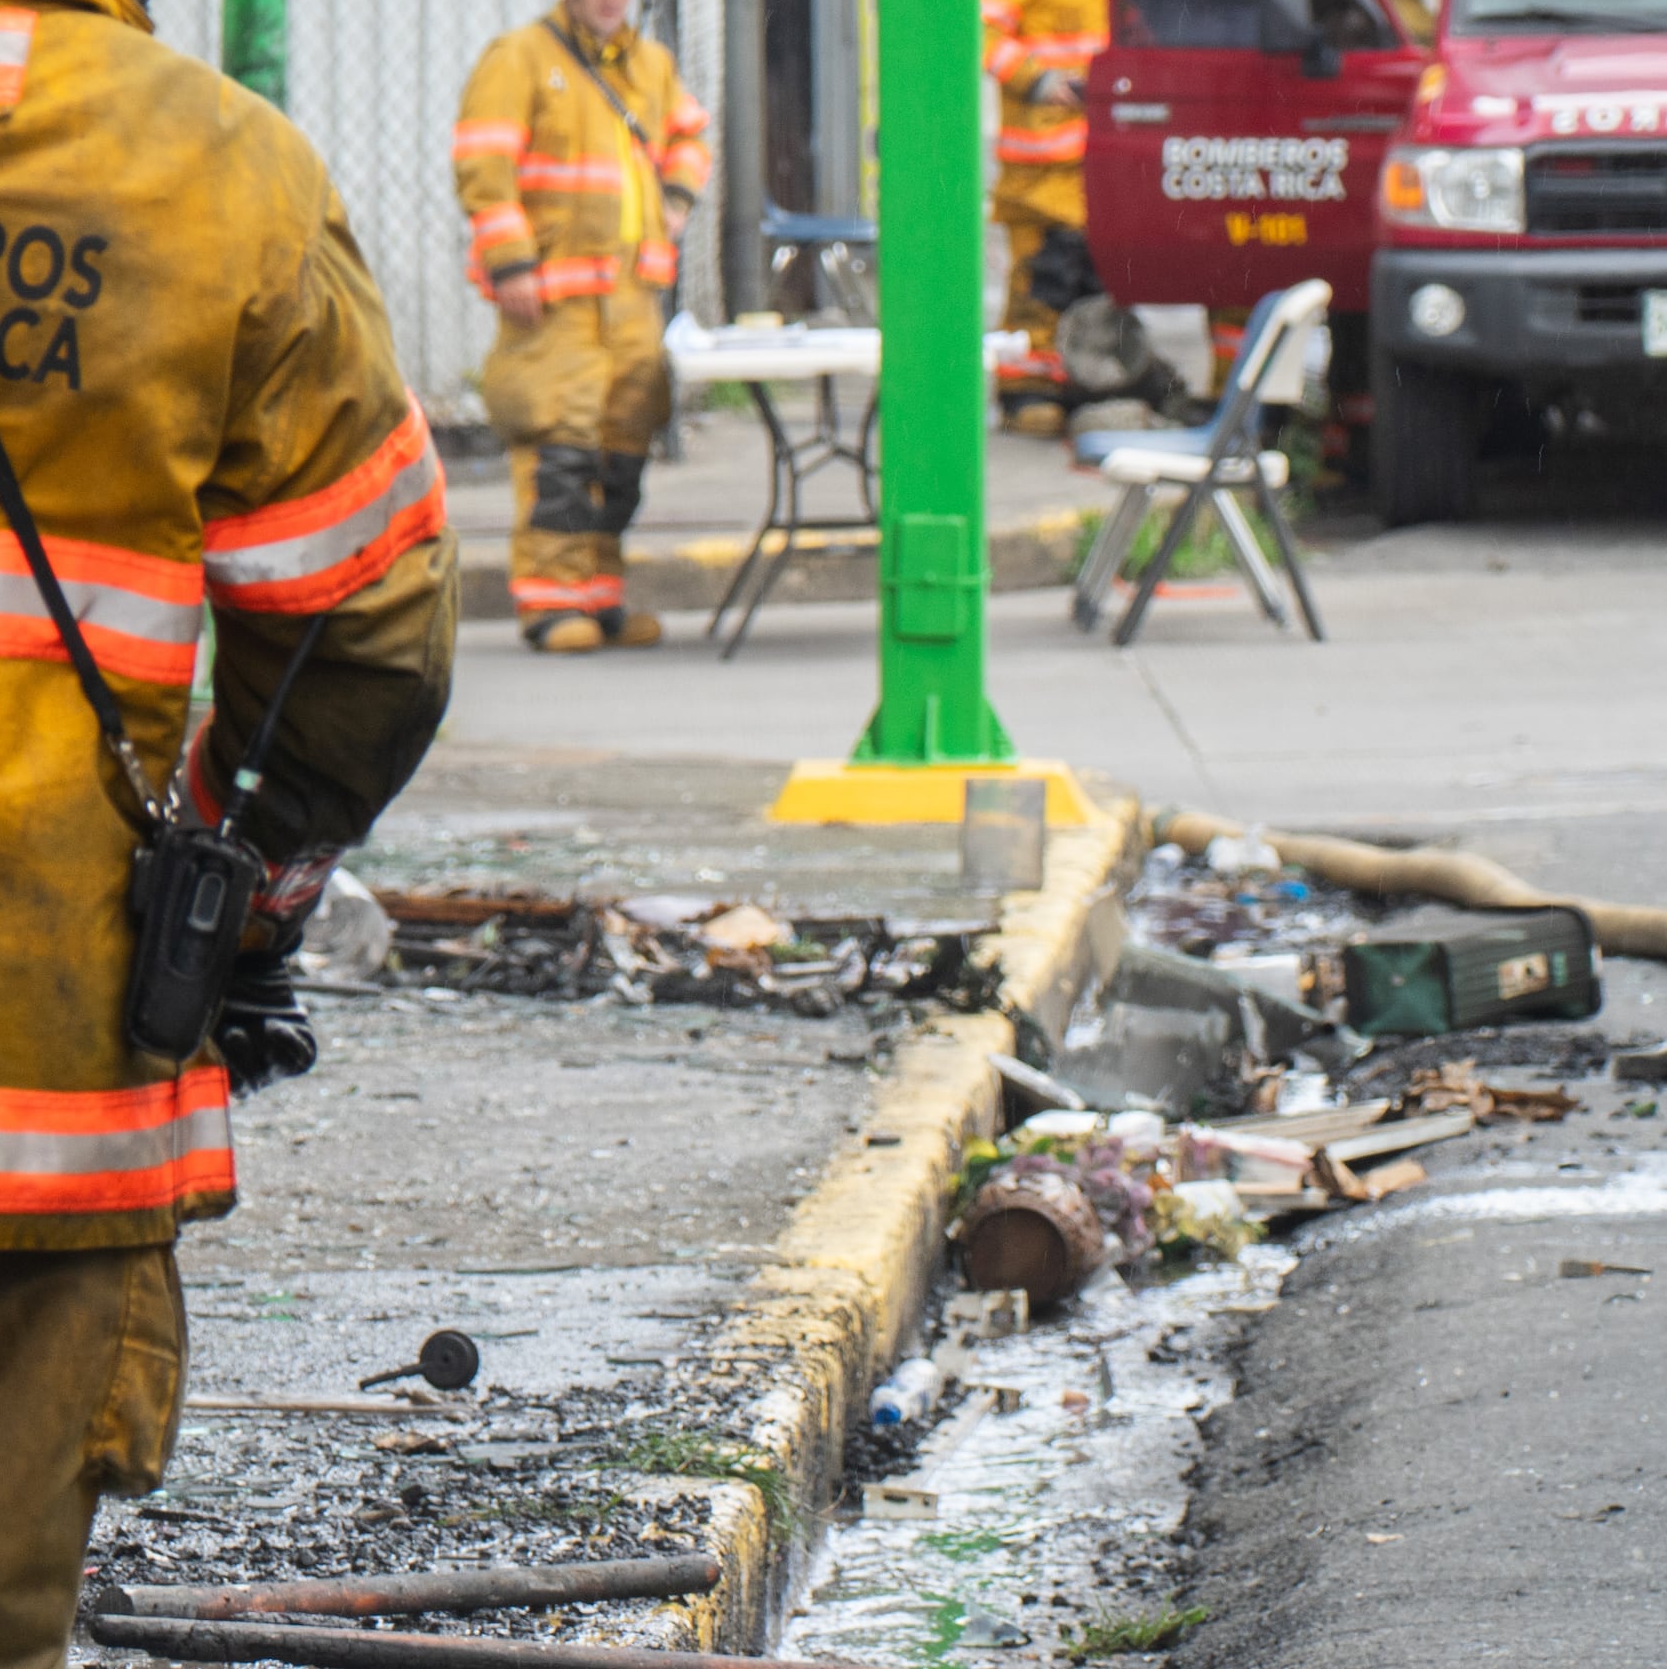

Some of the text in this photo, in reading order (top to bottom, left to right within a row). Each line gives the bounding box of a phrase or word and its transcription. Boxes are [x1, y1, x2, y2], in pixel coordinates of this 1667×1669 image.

[1162, 136, 1350, 171] BOMBEROS
[1162, 170, 1347, 201] COSTA RICA
